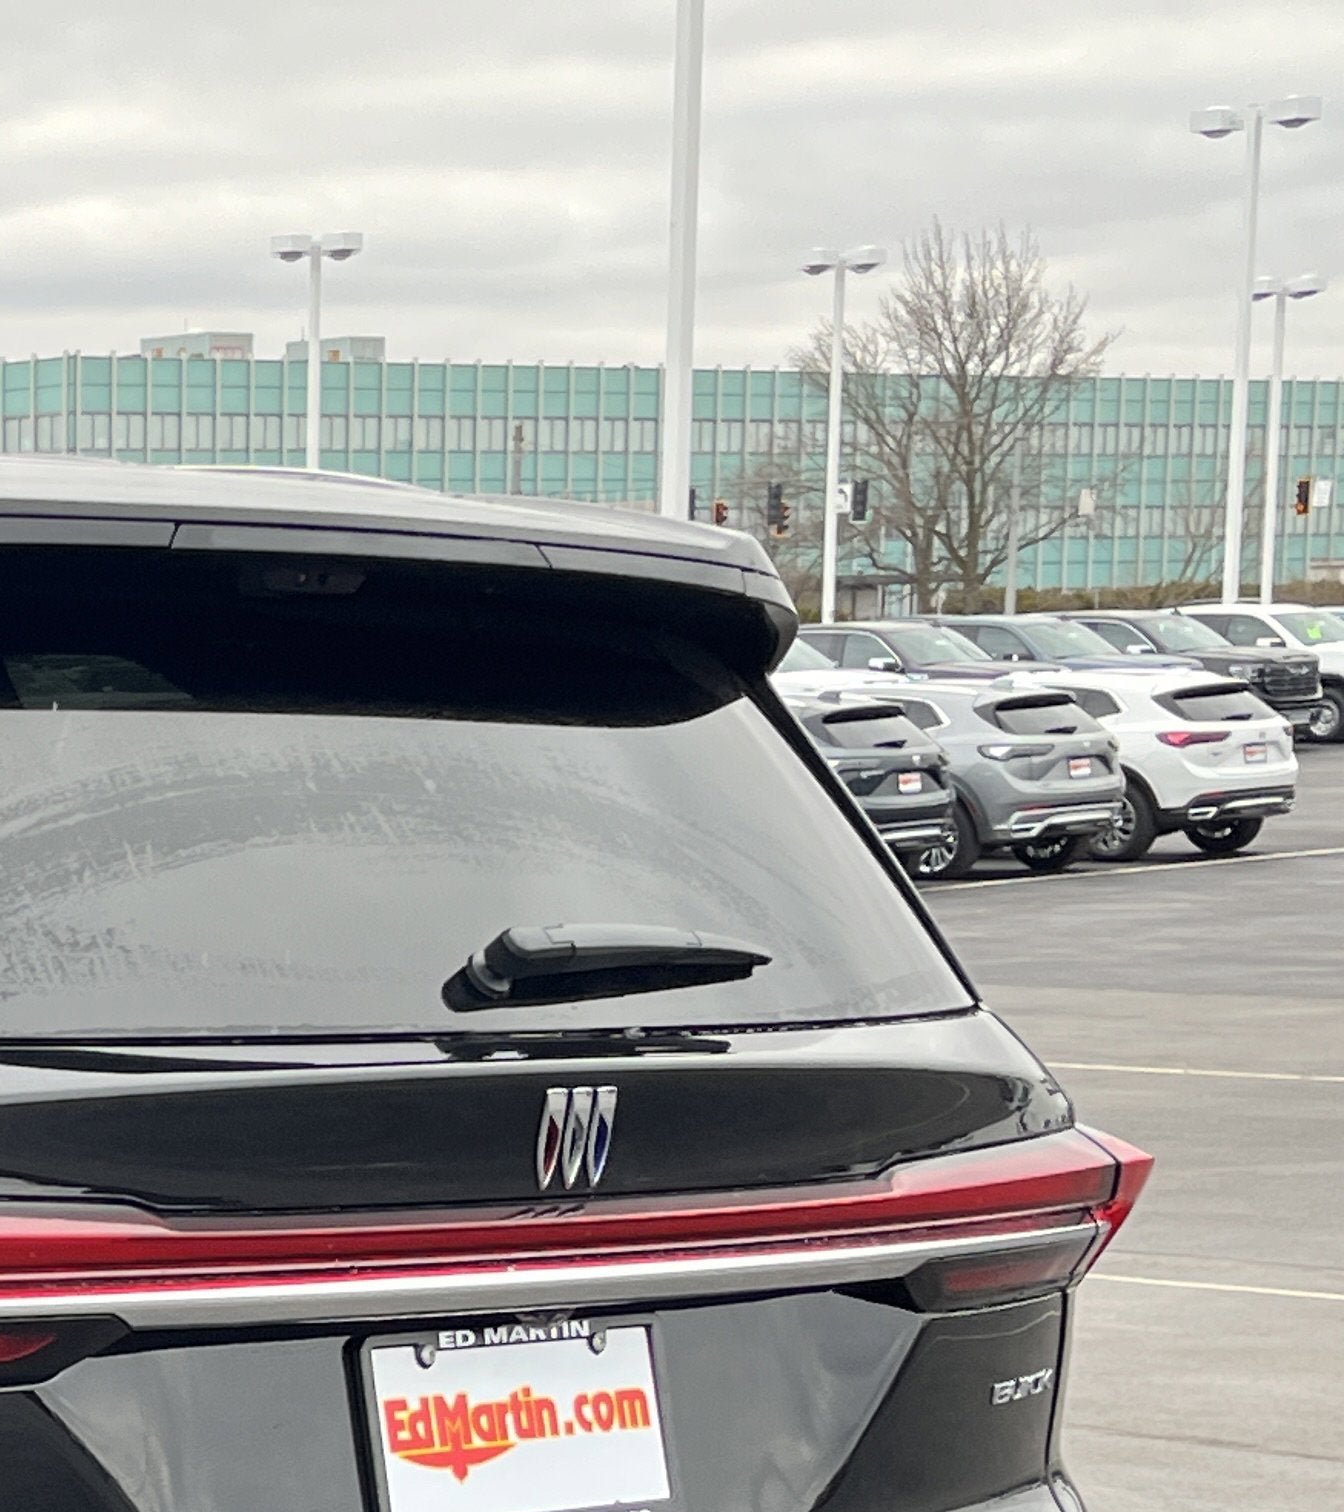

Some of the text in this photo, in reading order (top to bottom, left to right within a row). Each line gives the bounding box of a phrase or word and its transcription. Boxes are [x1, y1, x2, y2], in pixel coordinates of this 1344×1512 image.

[438, 1319, 590, 1348] ED MARTIN
[382, 1386, 651, 1453] EdMartin.com
